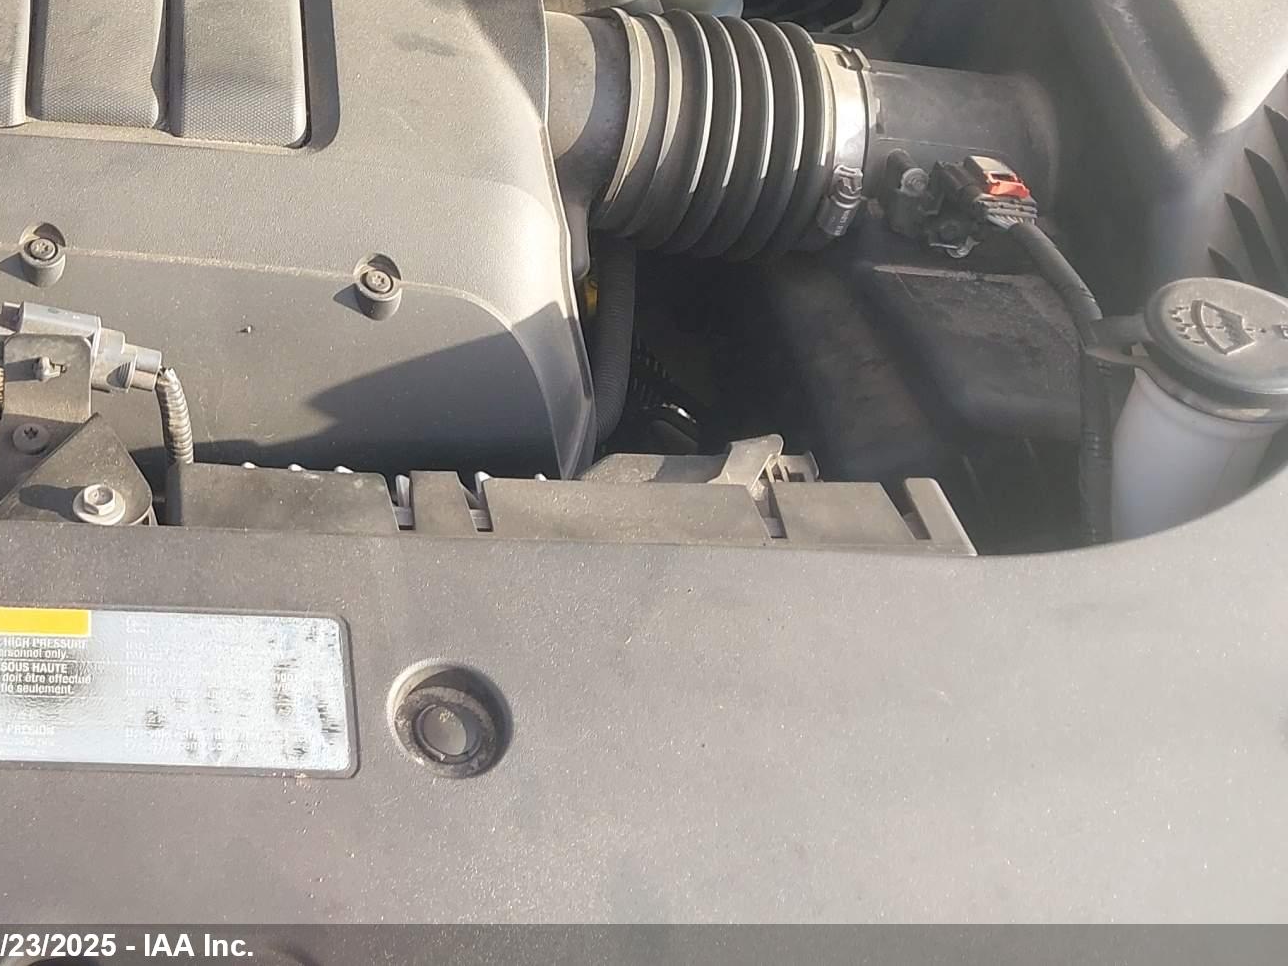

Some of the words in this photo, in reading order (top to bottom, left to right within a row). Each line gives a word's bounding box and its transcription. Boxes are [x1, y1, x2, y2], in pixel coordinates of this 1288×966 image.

[0, 662, 30, 673] SOUS
[32, 662, 68, 674] HAUTE
[2, 672, 22, 684] doit
[24, 672, 48, 684] être
